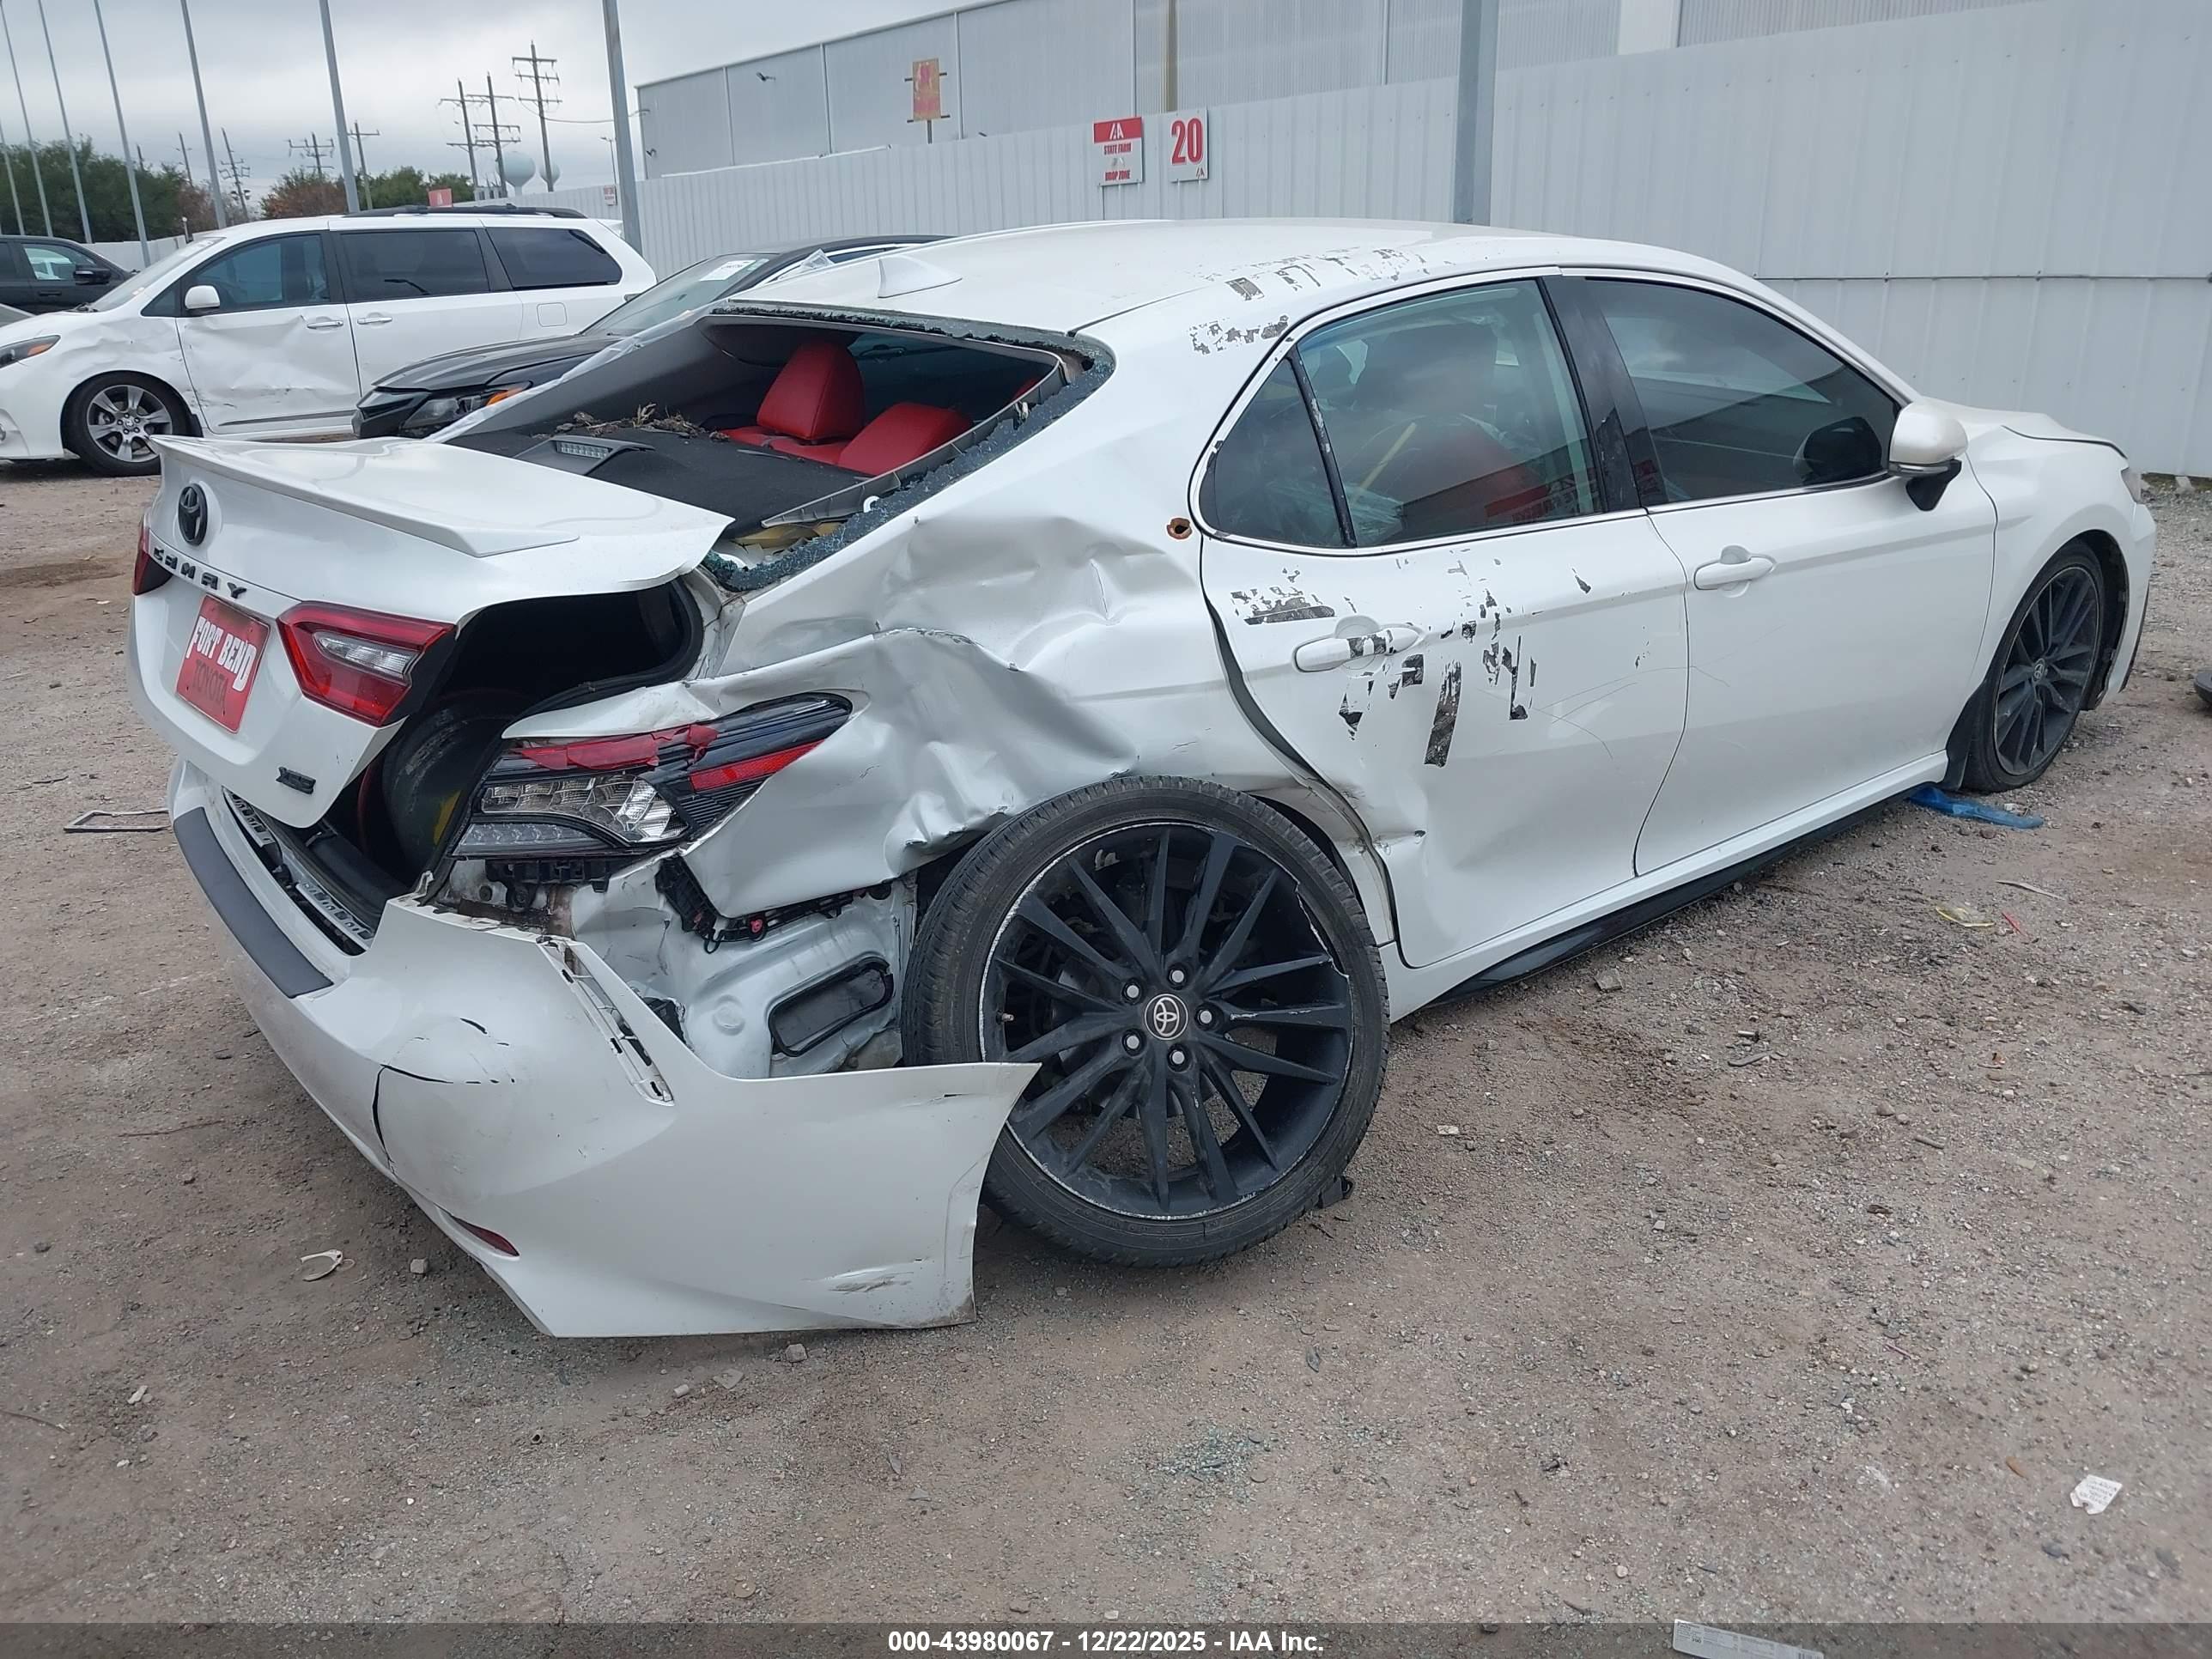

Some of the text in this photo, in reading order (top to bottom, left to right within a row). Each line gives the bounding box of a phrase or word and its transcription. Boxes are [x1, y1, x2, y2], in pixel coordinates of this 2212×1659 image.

[1171, 118, 1203, 165] 20
[185, 616, 257, 691] FORT BEND
